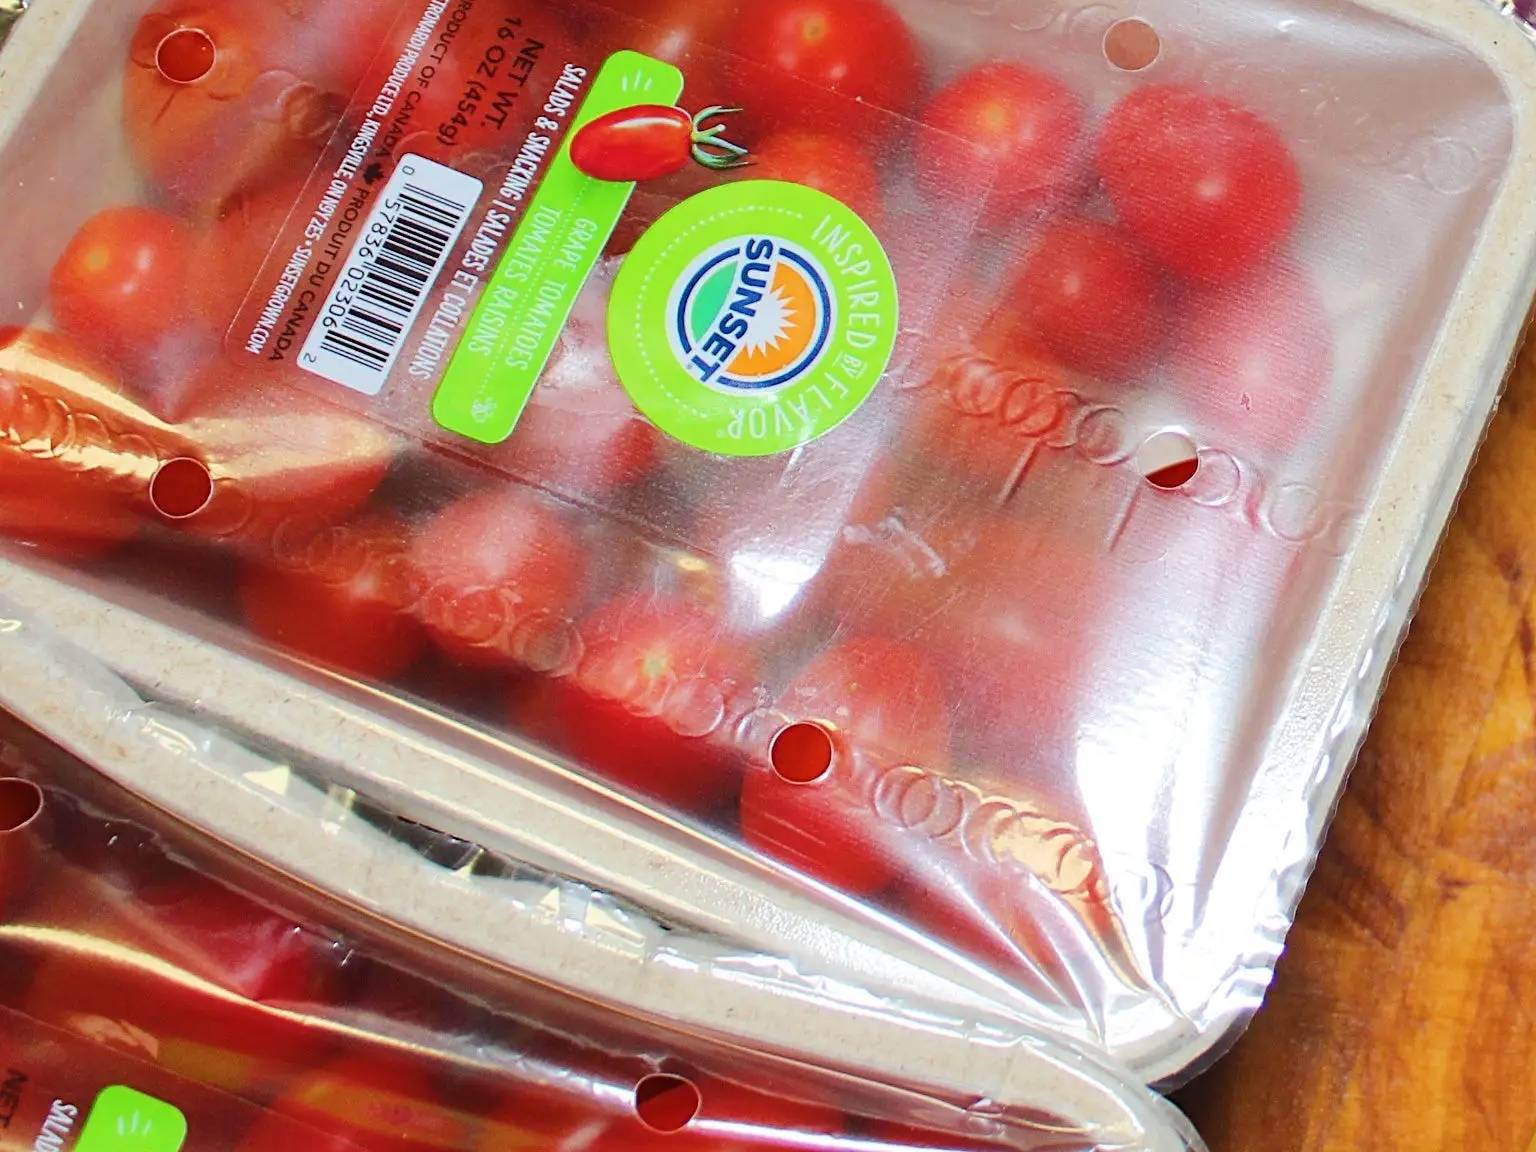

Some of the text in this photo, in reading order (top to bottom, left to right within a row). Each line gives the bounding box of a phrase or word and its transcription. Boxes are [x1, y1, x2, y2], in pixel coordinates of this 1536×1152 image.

[380, 46, 419, 100] PRODUCE
[416, 65, 436, 89] OF
[435, 17, 523, 147] 16 OZ (454g)
[480, 37, 545, 131] NET WT.
[333, 115, 380, 183] KINGSVILLE,
[374, 90, 421, 163] CANADA
[314, 194, 338, 221] N9Y
[324, 187, 370, 260] PRODUIT
[325, 176, 347, 200] ON
[405, 59, 587, 381] SALADS & SNACKING SALADES ET COLLATIONS
[302, 215, 327, 242] 2E5
[322, 198, 401, 328] 57836 02306
[243, 242, 313, 356] SUNSETGROWN.COM
[308, 261, 330, 288] DU
[467, 205, 562, 357] TOMATES RAISINS
[505, 218, 598, 371] GRAPE TOMATOES
[691, 238, 774, 382] SUNSET
[810, 215, 881, 349] INSPIRED
[267, 289, 316, 361] CANADA
